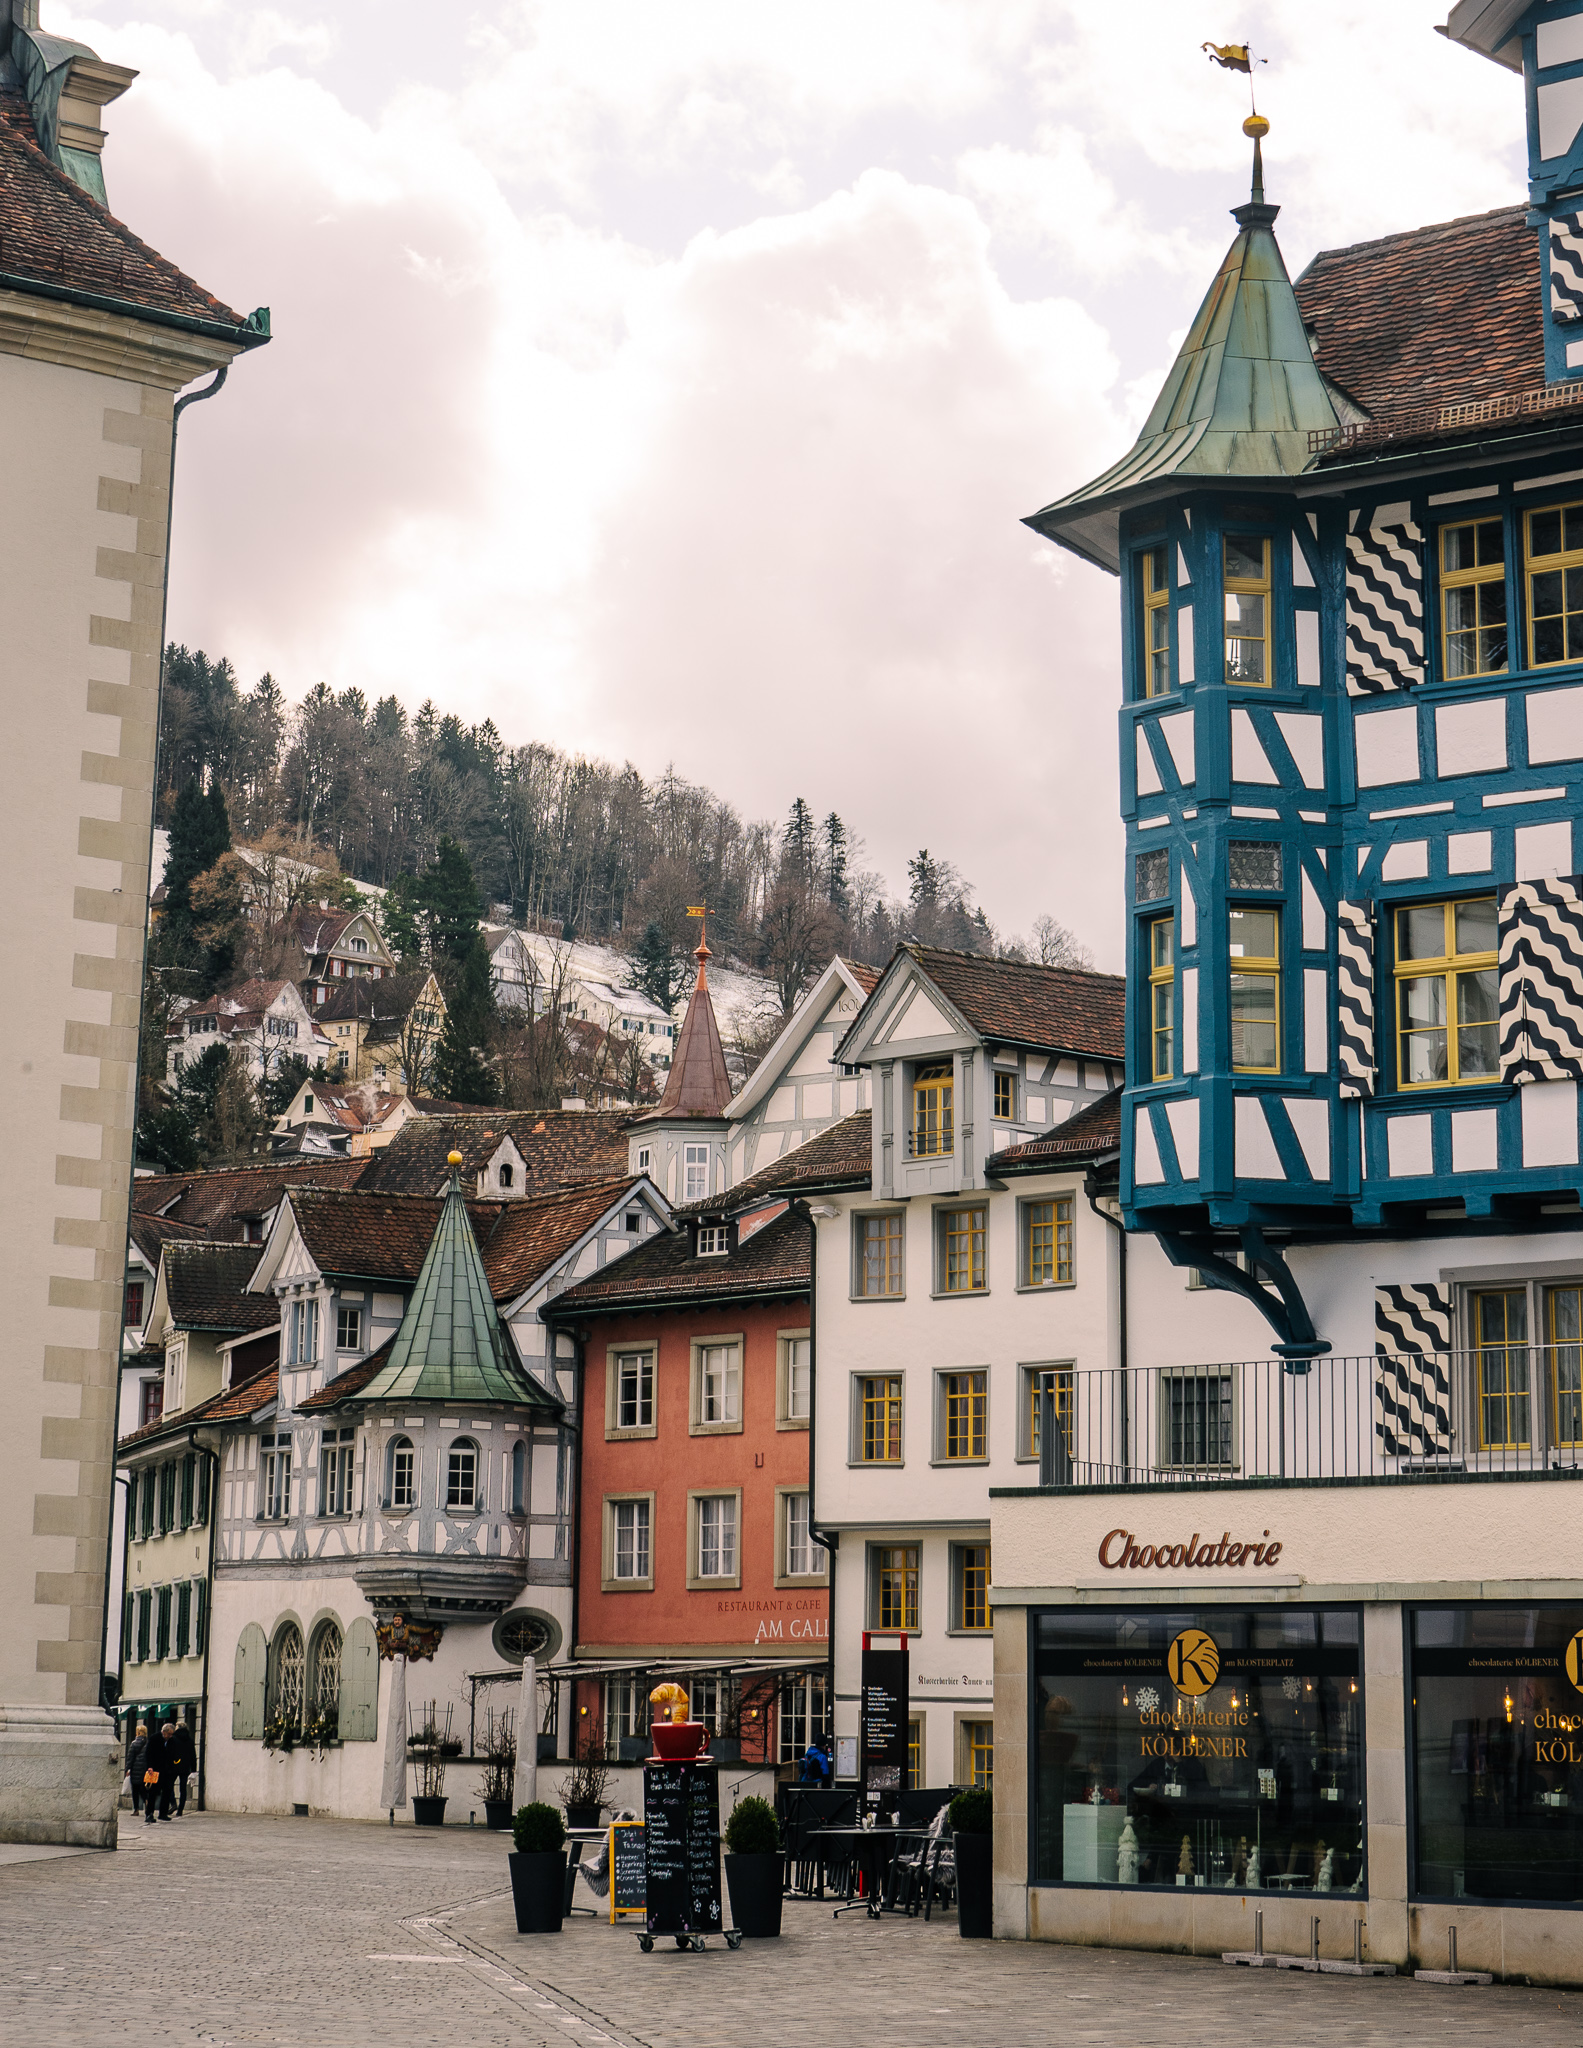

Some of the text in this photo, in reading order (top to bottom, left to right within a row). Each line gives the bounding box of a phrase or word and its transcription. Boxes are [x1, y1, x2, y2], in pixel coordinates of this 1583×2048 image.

[1098, 1529, 1283, 1568] Chocolaterie
[717, 1599, 821, 1611] RESTAURANT & CAFE
[756, 1620, 783, 1638] AM
[1083, 1657, 1162, 1668] chocolaterie KÖLBENER
[1237, 1658, 1294, 1667] KLOSTERPLATZ
[1468, 1657, 1559, 1667] chocolaterie KÖLBENER
[1139, 1706, 1249, 1726] chocolaterie
[1140, 1732, 1248, 1757] KÖLBENER
